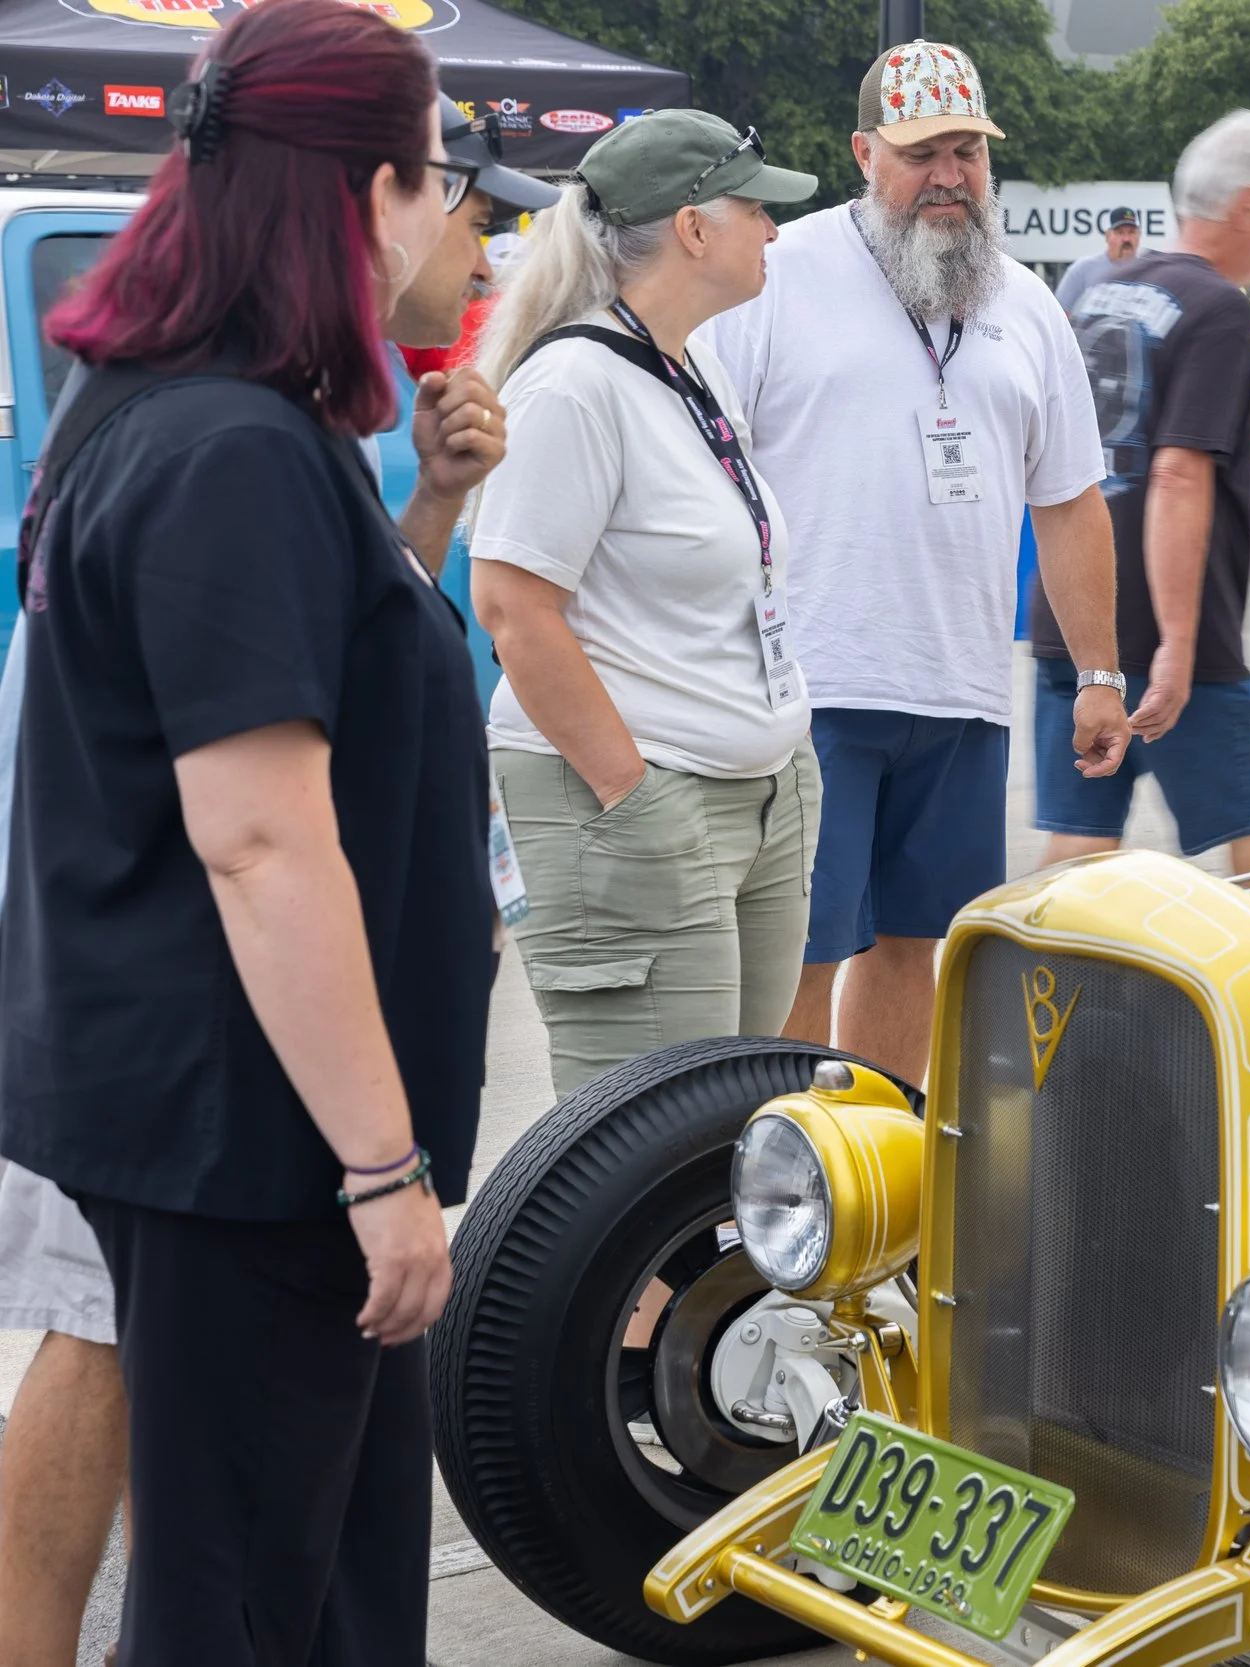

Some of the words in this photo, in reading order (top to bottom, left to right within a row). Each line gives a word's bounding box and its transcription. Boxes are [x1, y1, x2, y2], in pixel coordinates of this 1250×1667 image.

[24, 91, 55, 102] Dakota
[56, 92, 86, 103] Digital
[107, 92, 161, 110] TANKS
[1005, 208, 1165, 236] LAUSCE
[820, 1430, 1052, 1589] D39-337
